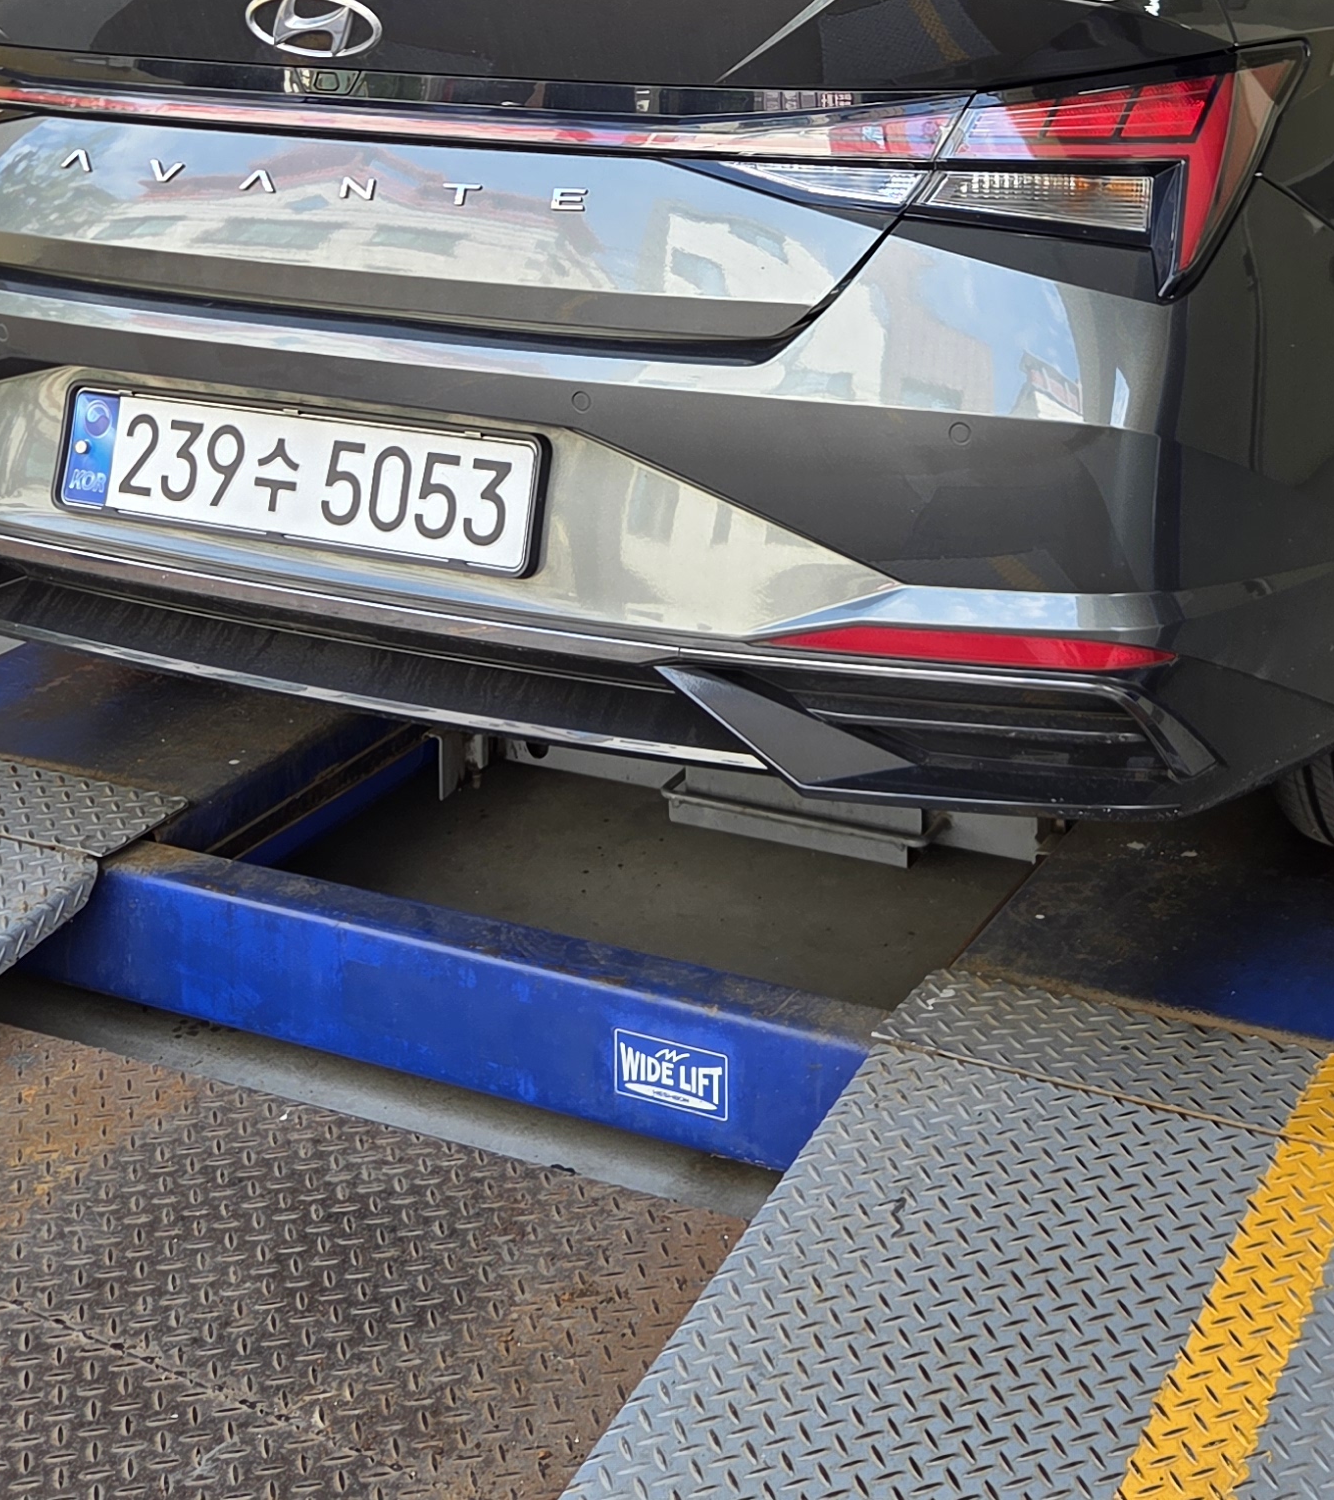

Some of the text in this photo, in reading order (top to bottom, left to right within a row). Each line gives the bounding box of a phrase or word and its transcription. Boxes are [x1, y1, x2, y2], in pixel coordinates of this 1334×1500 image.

[60, 147, 589, 212] AVANTE
[69, 468, 107, 493] KOR
[321, 440, 513, 546] 5053
[620, 1041, 723, 1105] WIDE LIFT
